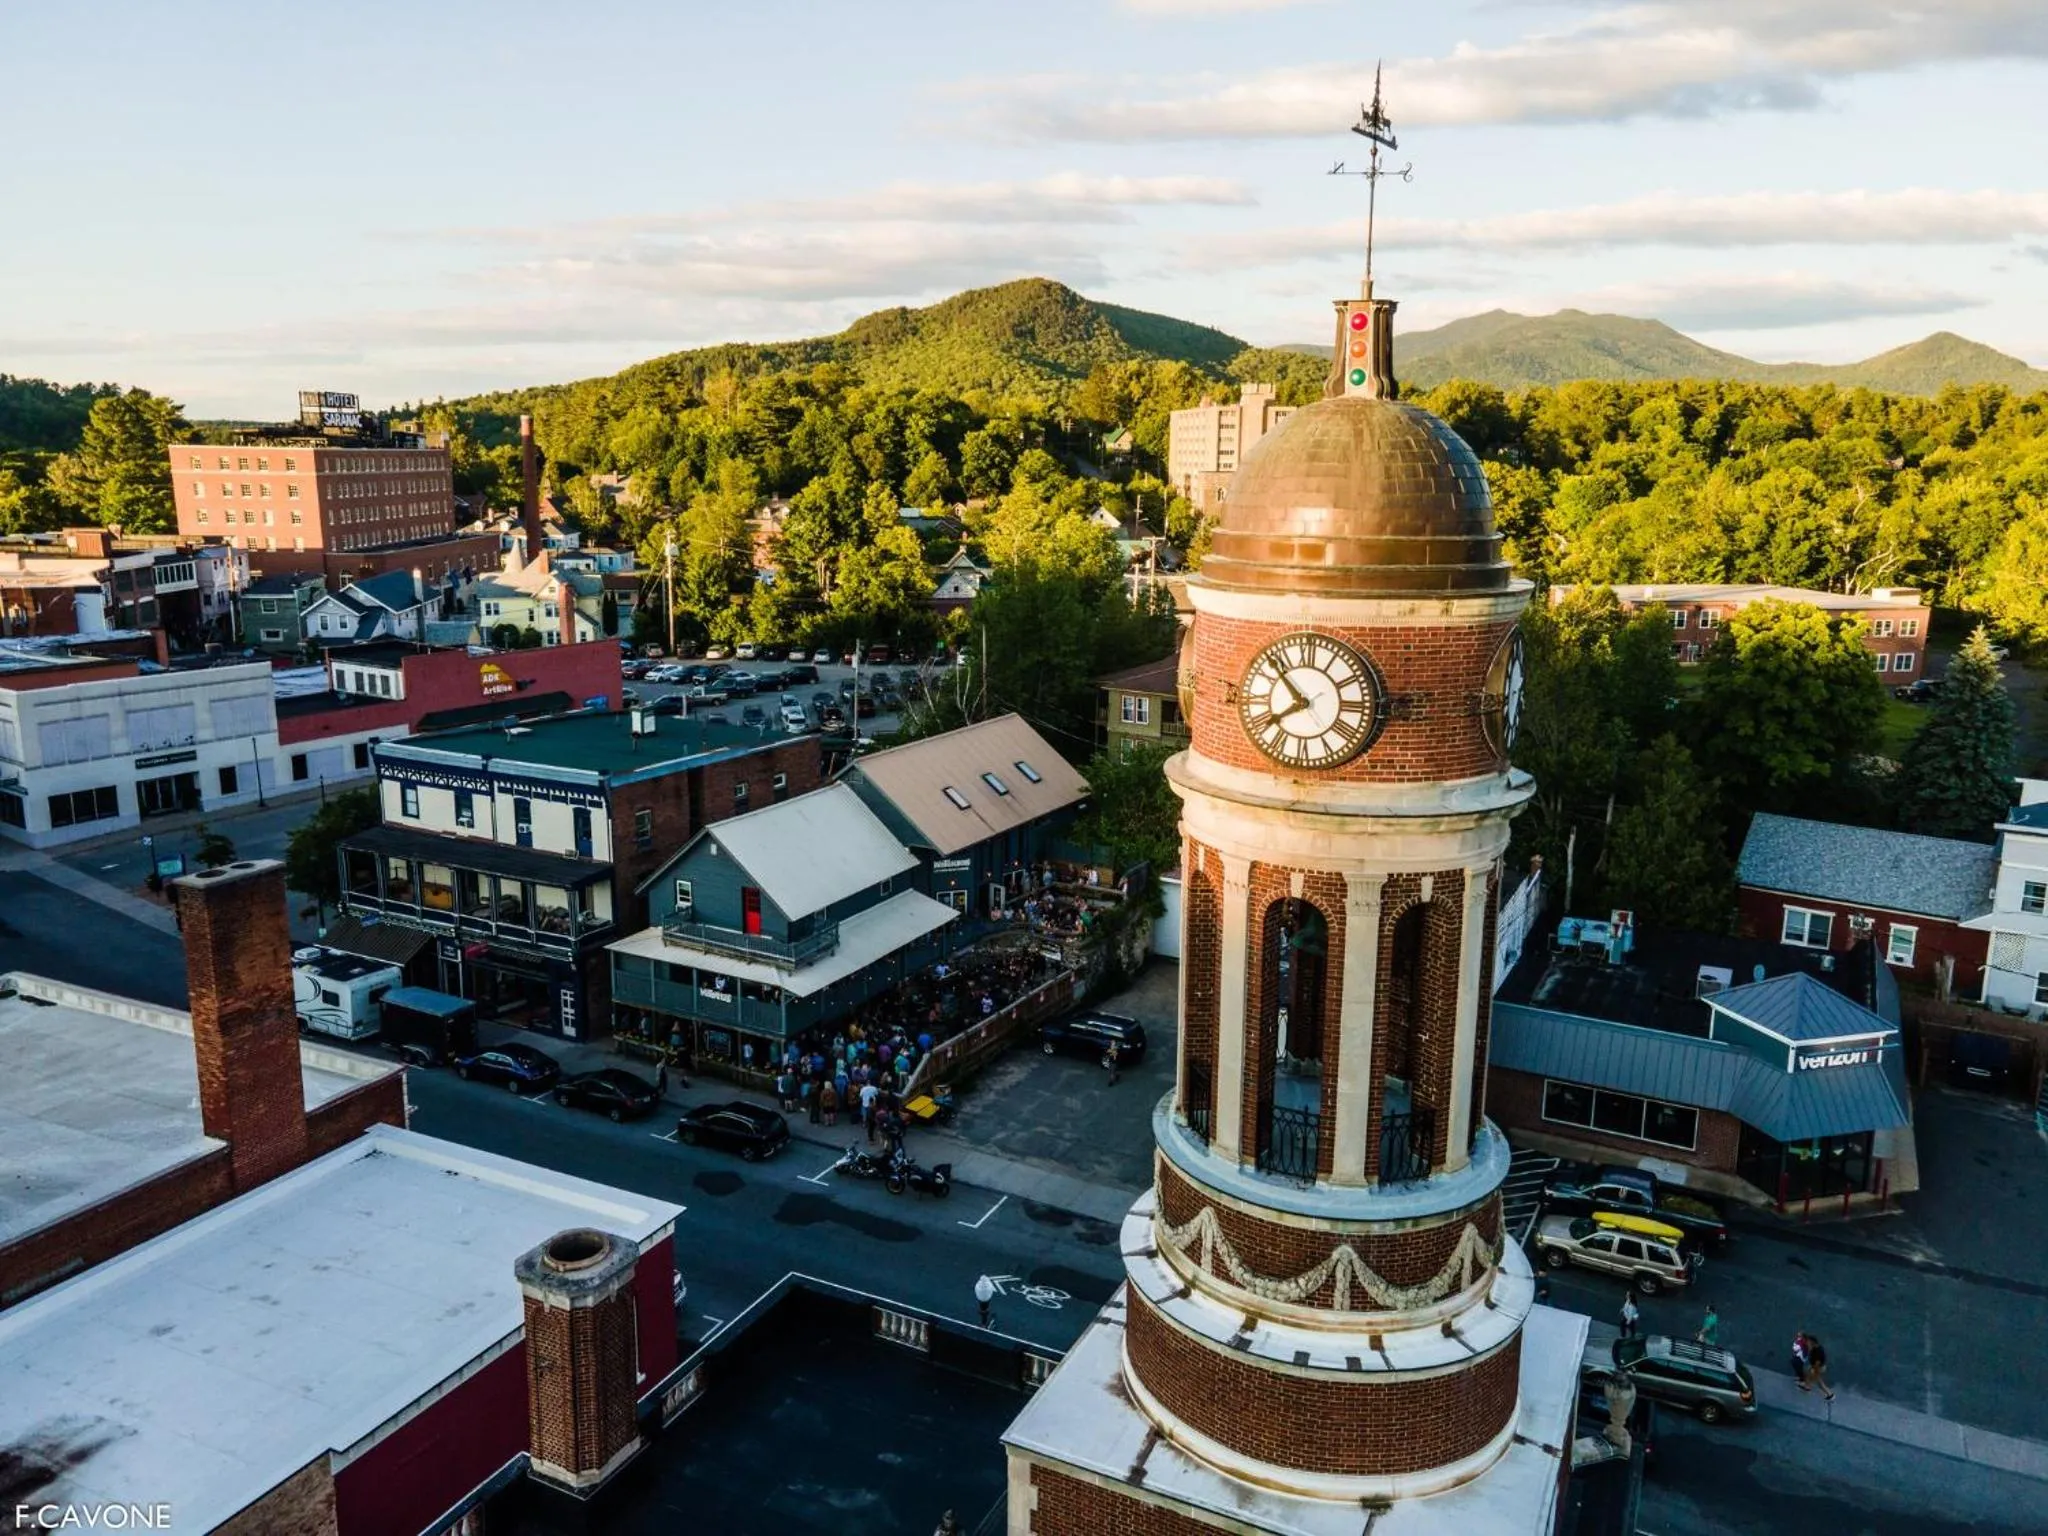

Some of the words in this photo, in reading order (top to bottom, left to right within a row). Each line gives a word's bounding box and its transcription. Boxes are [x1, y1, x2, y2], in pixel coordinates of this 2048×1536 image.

[326, 393, 356, 407] HOTEL
[323, 412, 362, 427] SARANAC
[1339, 699, 1363, 714] III
[1799, 1048, 1868, 1070] verizon
